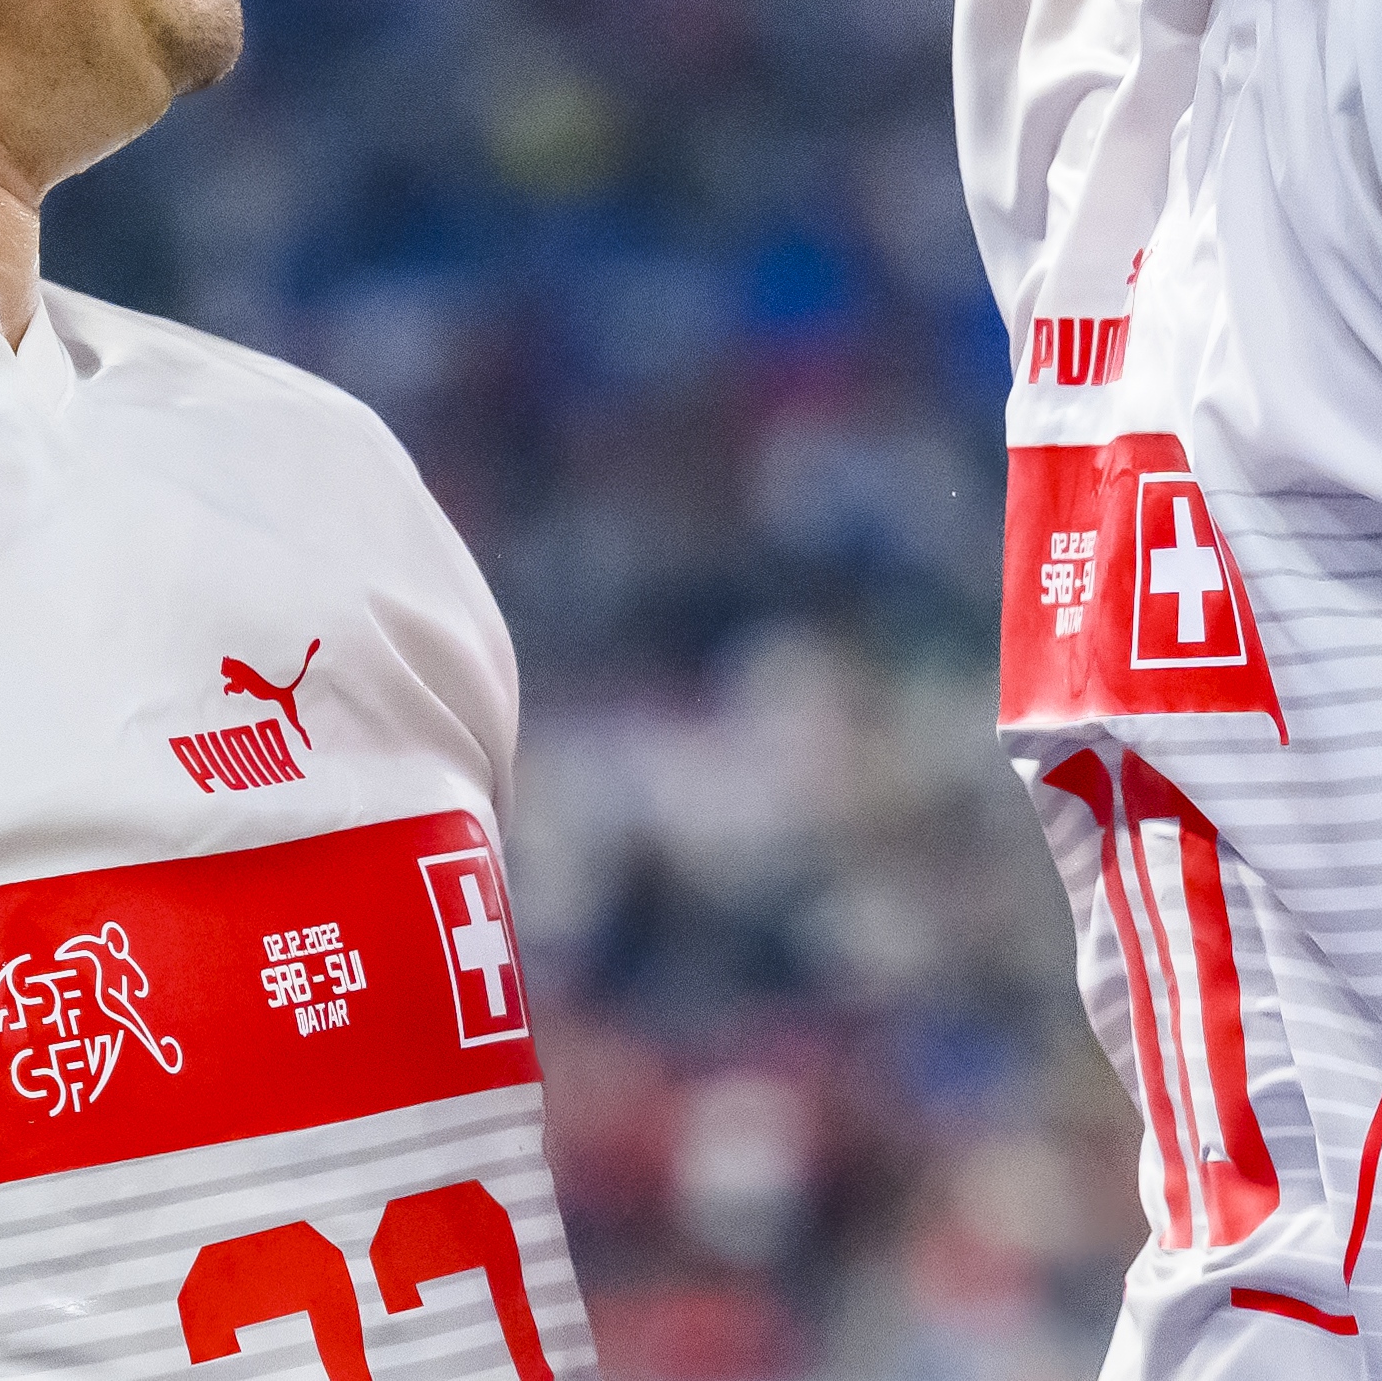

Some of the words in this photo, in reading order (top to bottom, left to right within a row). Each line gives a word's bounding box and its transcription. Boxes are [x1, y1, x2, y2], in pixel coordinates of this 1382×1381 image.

[168, 718, 306, 793] PUMA
[262, 922, 344, 962] 02.12.2022
[294, 998, 351, 1037] QATAR
